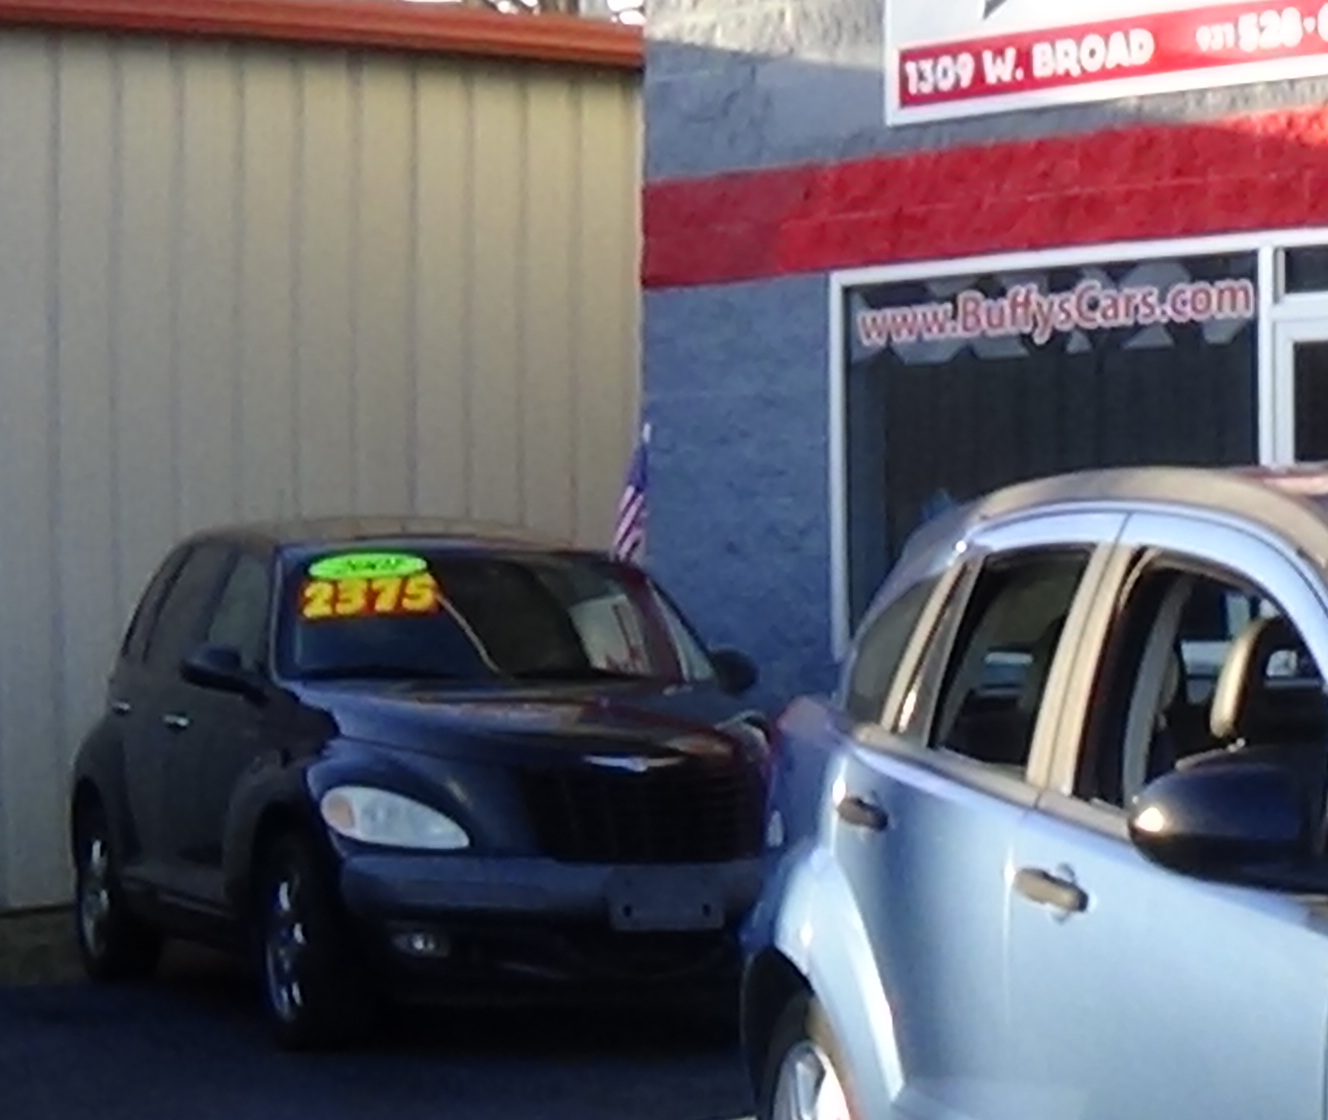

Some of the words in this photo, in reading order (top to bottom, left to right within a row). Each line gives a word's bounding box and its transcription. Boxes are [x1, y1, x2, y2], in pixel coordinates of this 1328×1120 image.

[905, 53, 975, 95] 1309
[982, 46, 1024, 84] W.
[1032, 28, 1156, 77] BROAD
[857, 278, 1254, 346] www.BuffysCars.com
[302, 572, 437, 619] 2375
